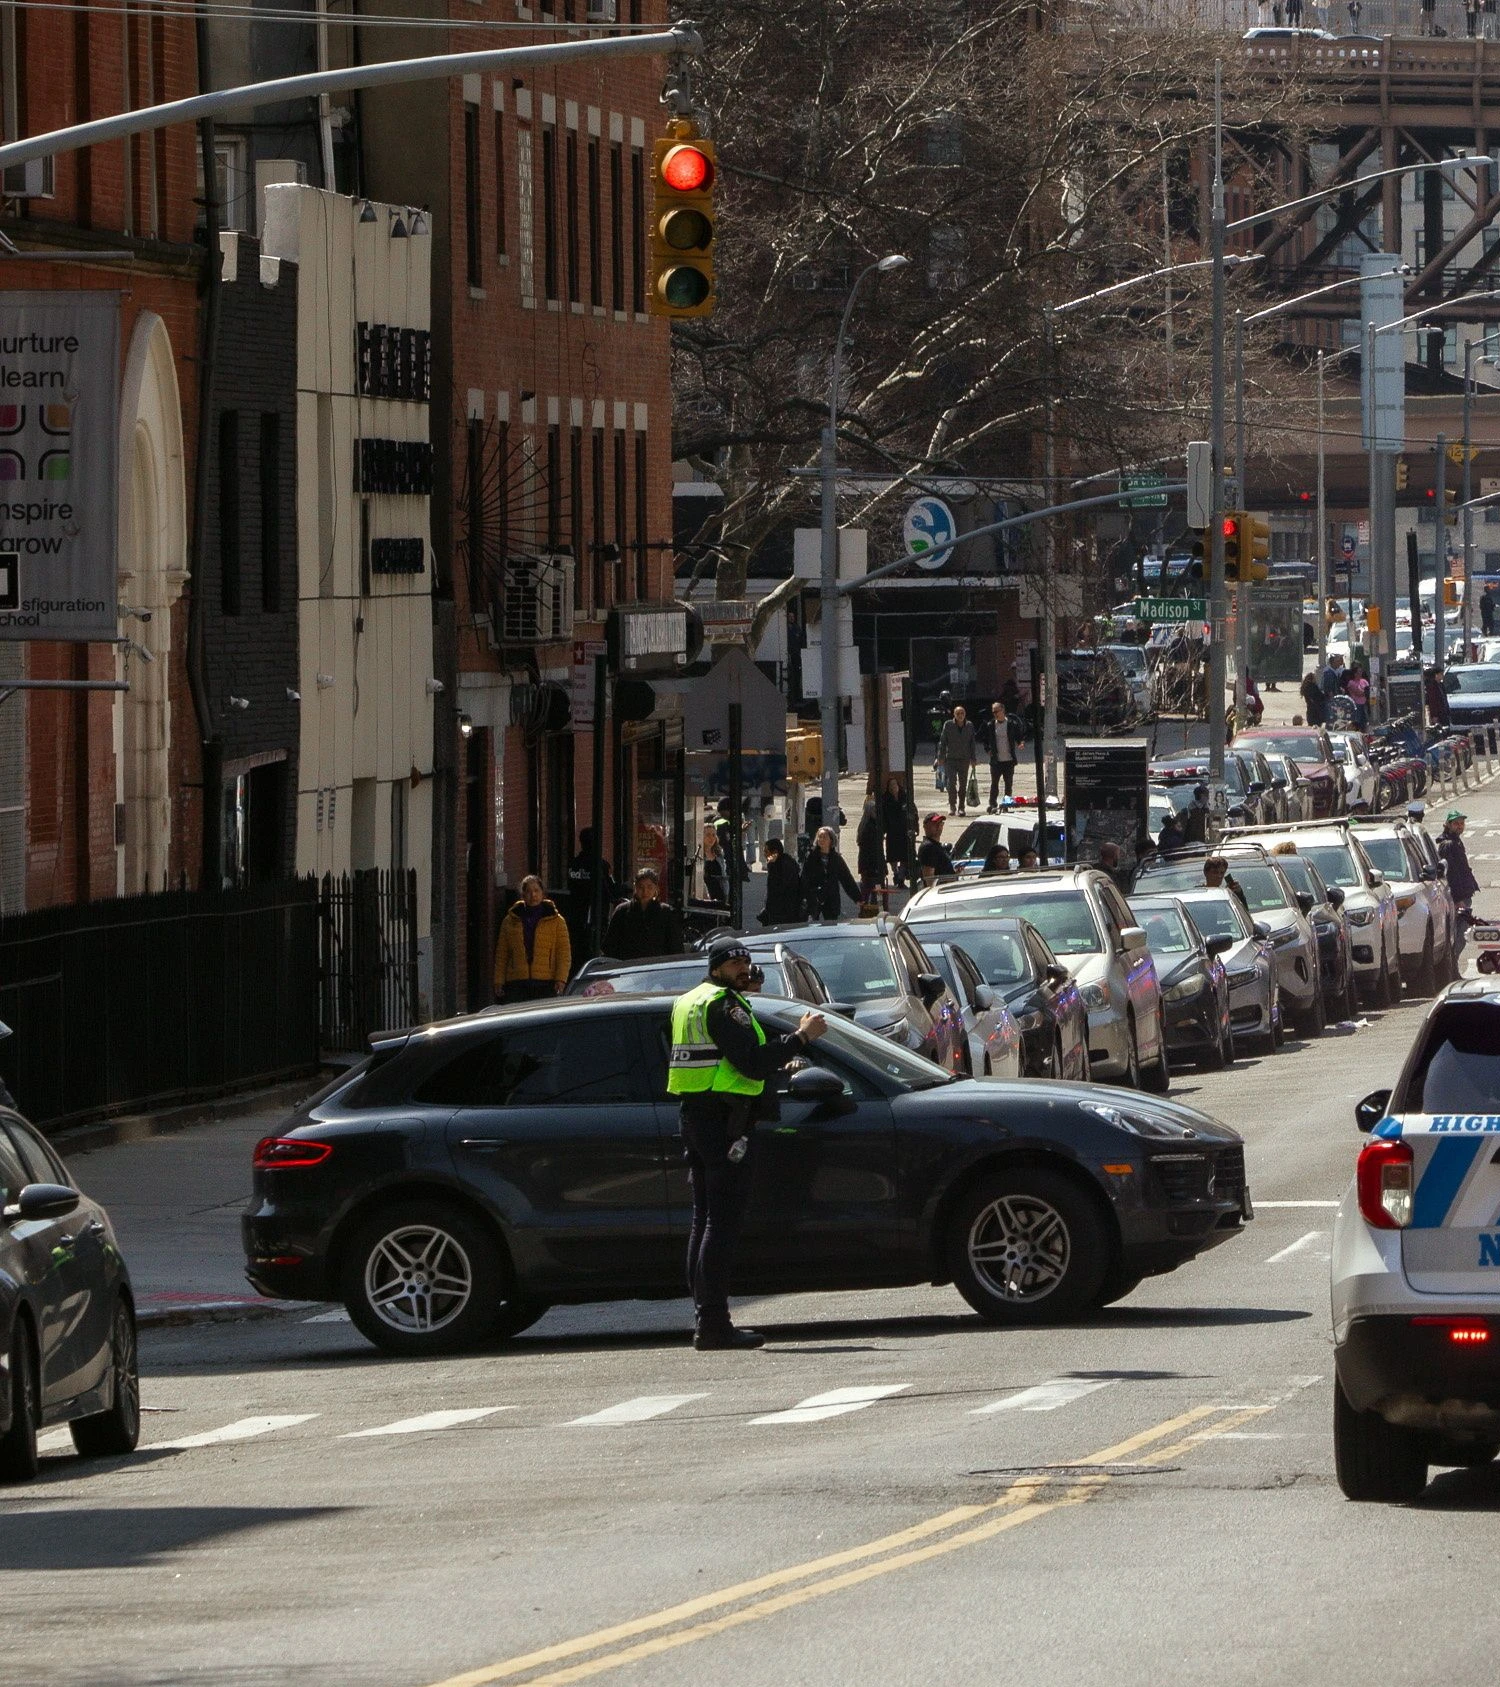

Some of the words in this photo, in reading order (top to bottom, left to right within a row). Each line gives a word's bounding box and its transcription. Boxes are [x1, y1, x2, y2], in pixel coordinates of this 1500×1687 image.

[0, 333, 79, 354] urture
[1, 365, 65, 388] learn
[0, 498, 73, 525] nspire
[22, 598, 105, 614] sfiguration
[1140, 600, 1189, 618] Madison
[1192, 601, 1201, 611] St
[0, 613, 40, 626] chool
